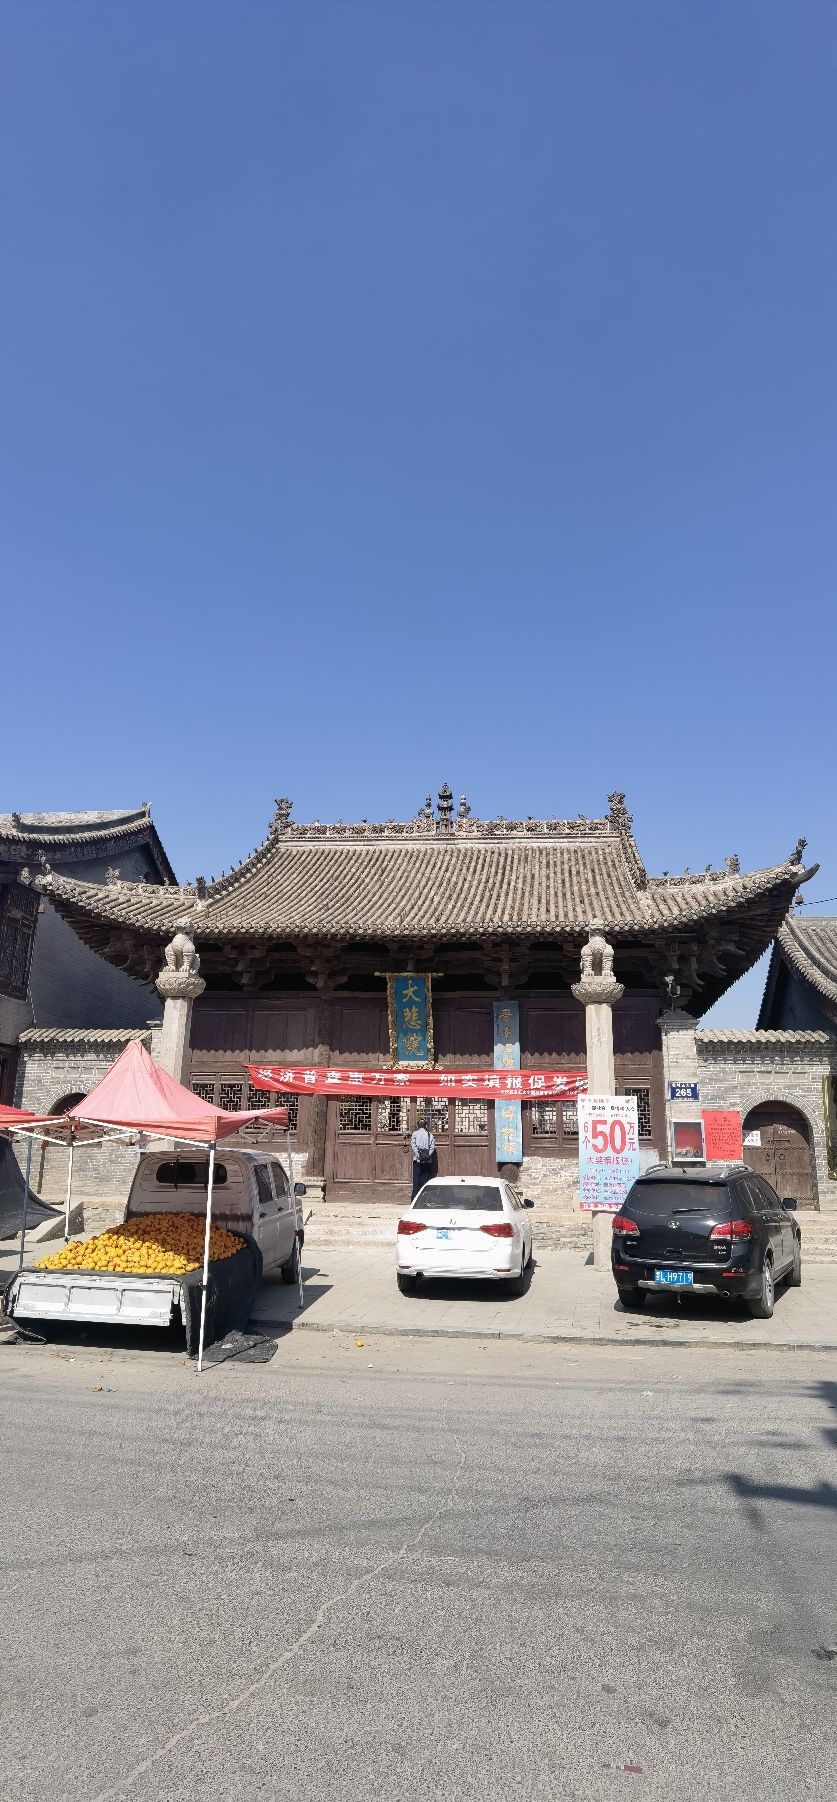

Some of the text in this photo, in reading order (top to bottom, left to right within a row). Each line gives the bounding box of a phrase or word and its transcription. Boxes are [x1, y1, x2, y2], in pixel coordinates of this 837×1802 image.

[257, 1068, 411, 1086] 经济普查惠万家
[675, 1088, 692, 1097] 265
[591, 1119, 626, 1154] 50
